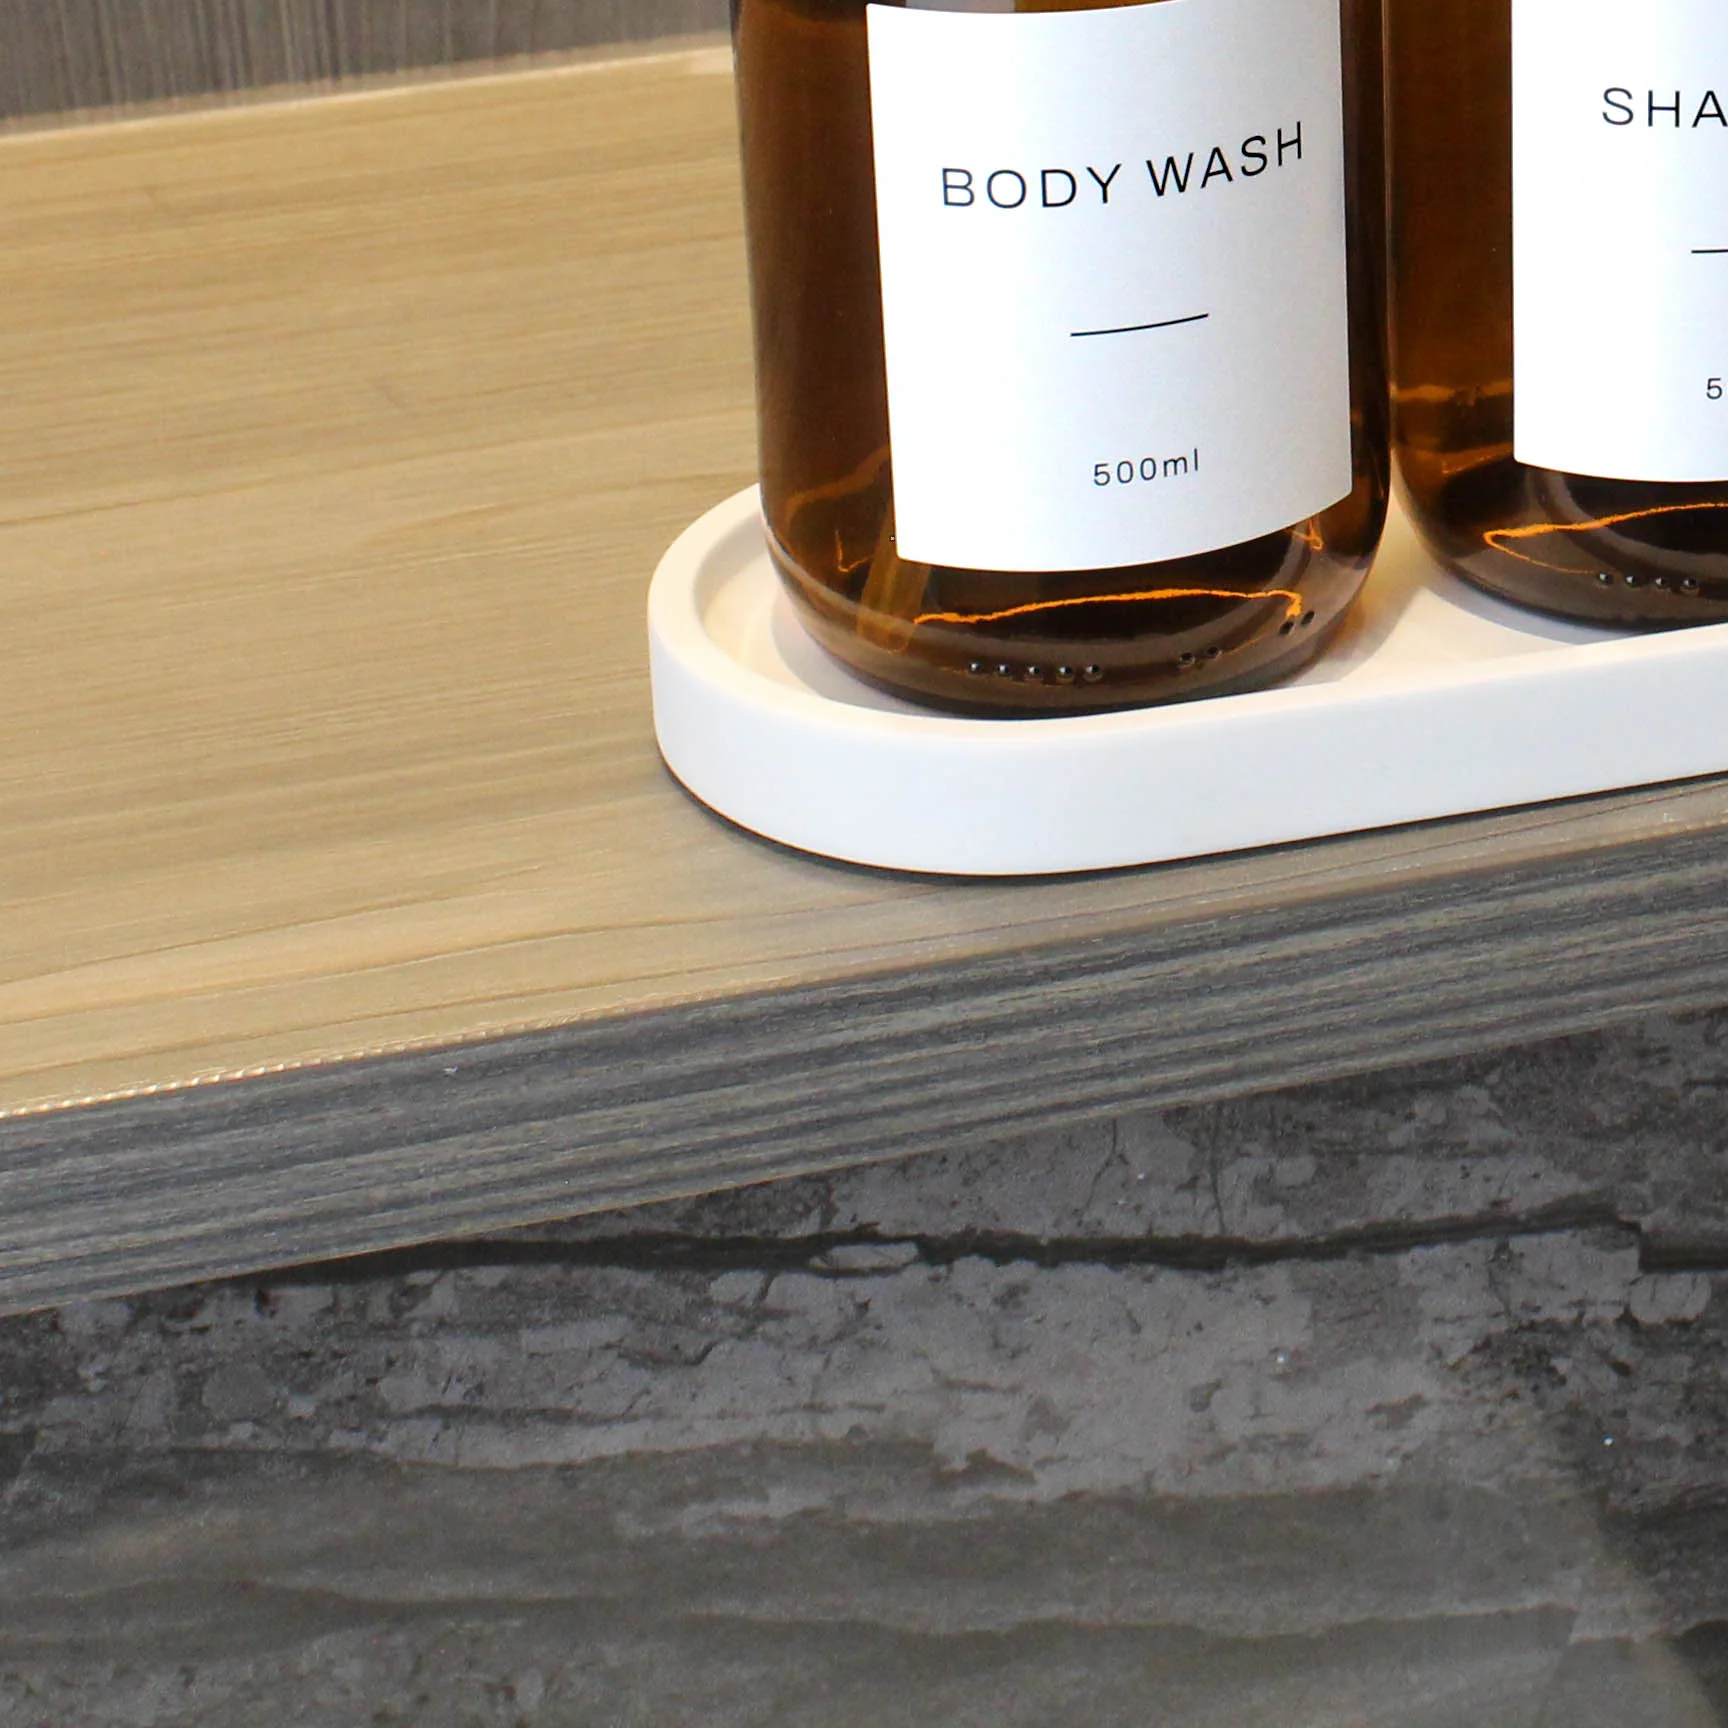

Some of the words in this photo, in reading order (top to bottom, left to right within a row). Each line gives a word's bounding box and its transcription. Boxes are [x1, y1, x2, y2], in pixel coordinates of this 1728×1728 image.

[942, 163, 1122, 209] BODY
[1145, 120, 1303, 198] WASH
[1093, 447, 1199, 487] 500ml
